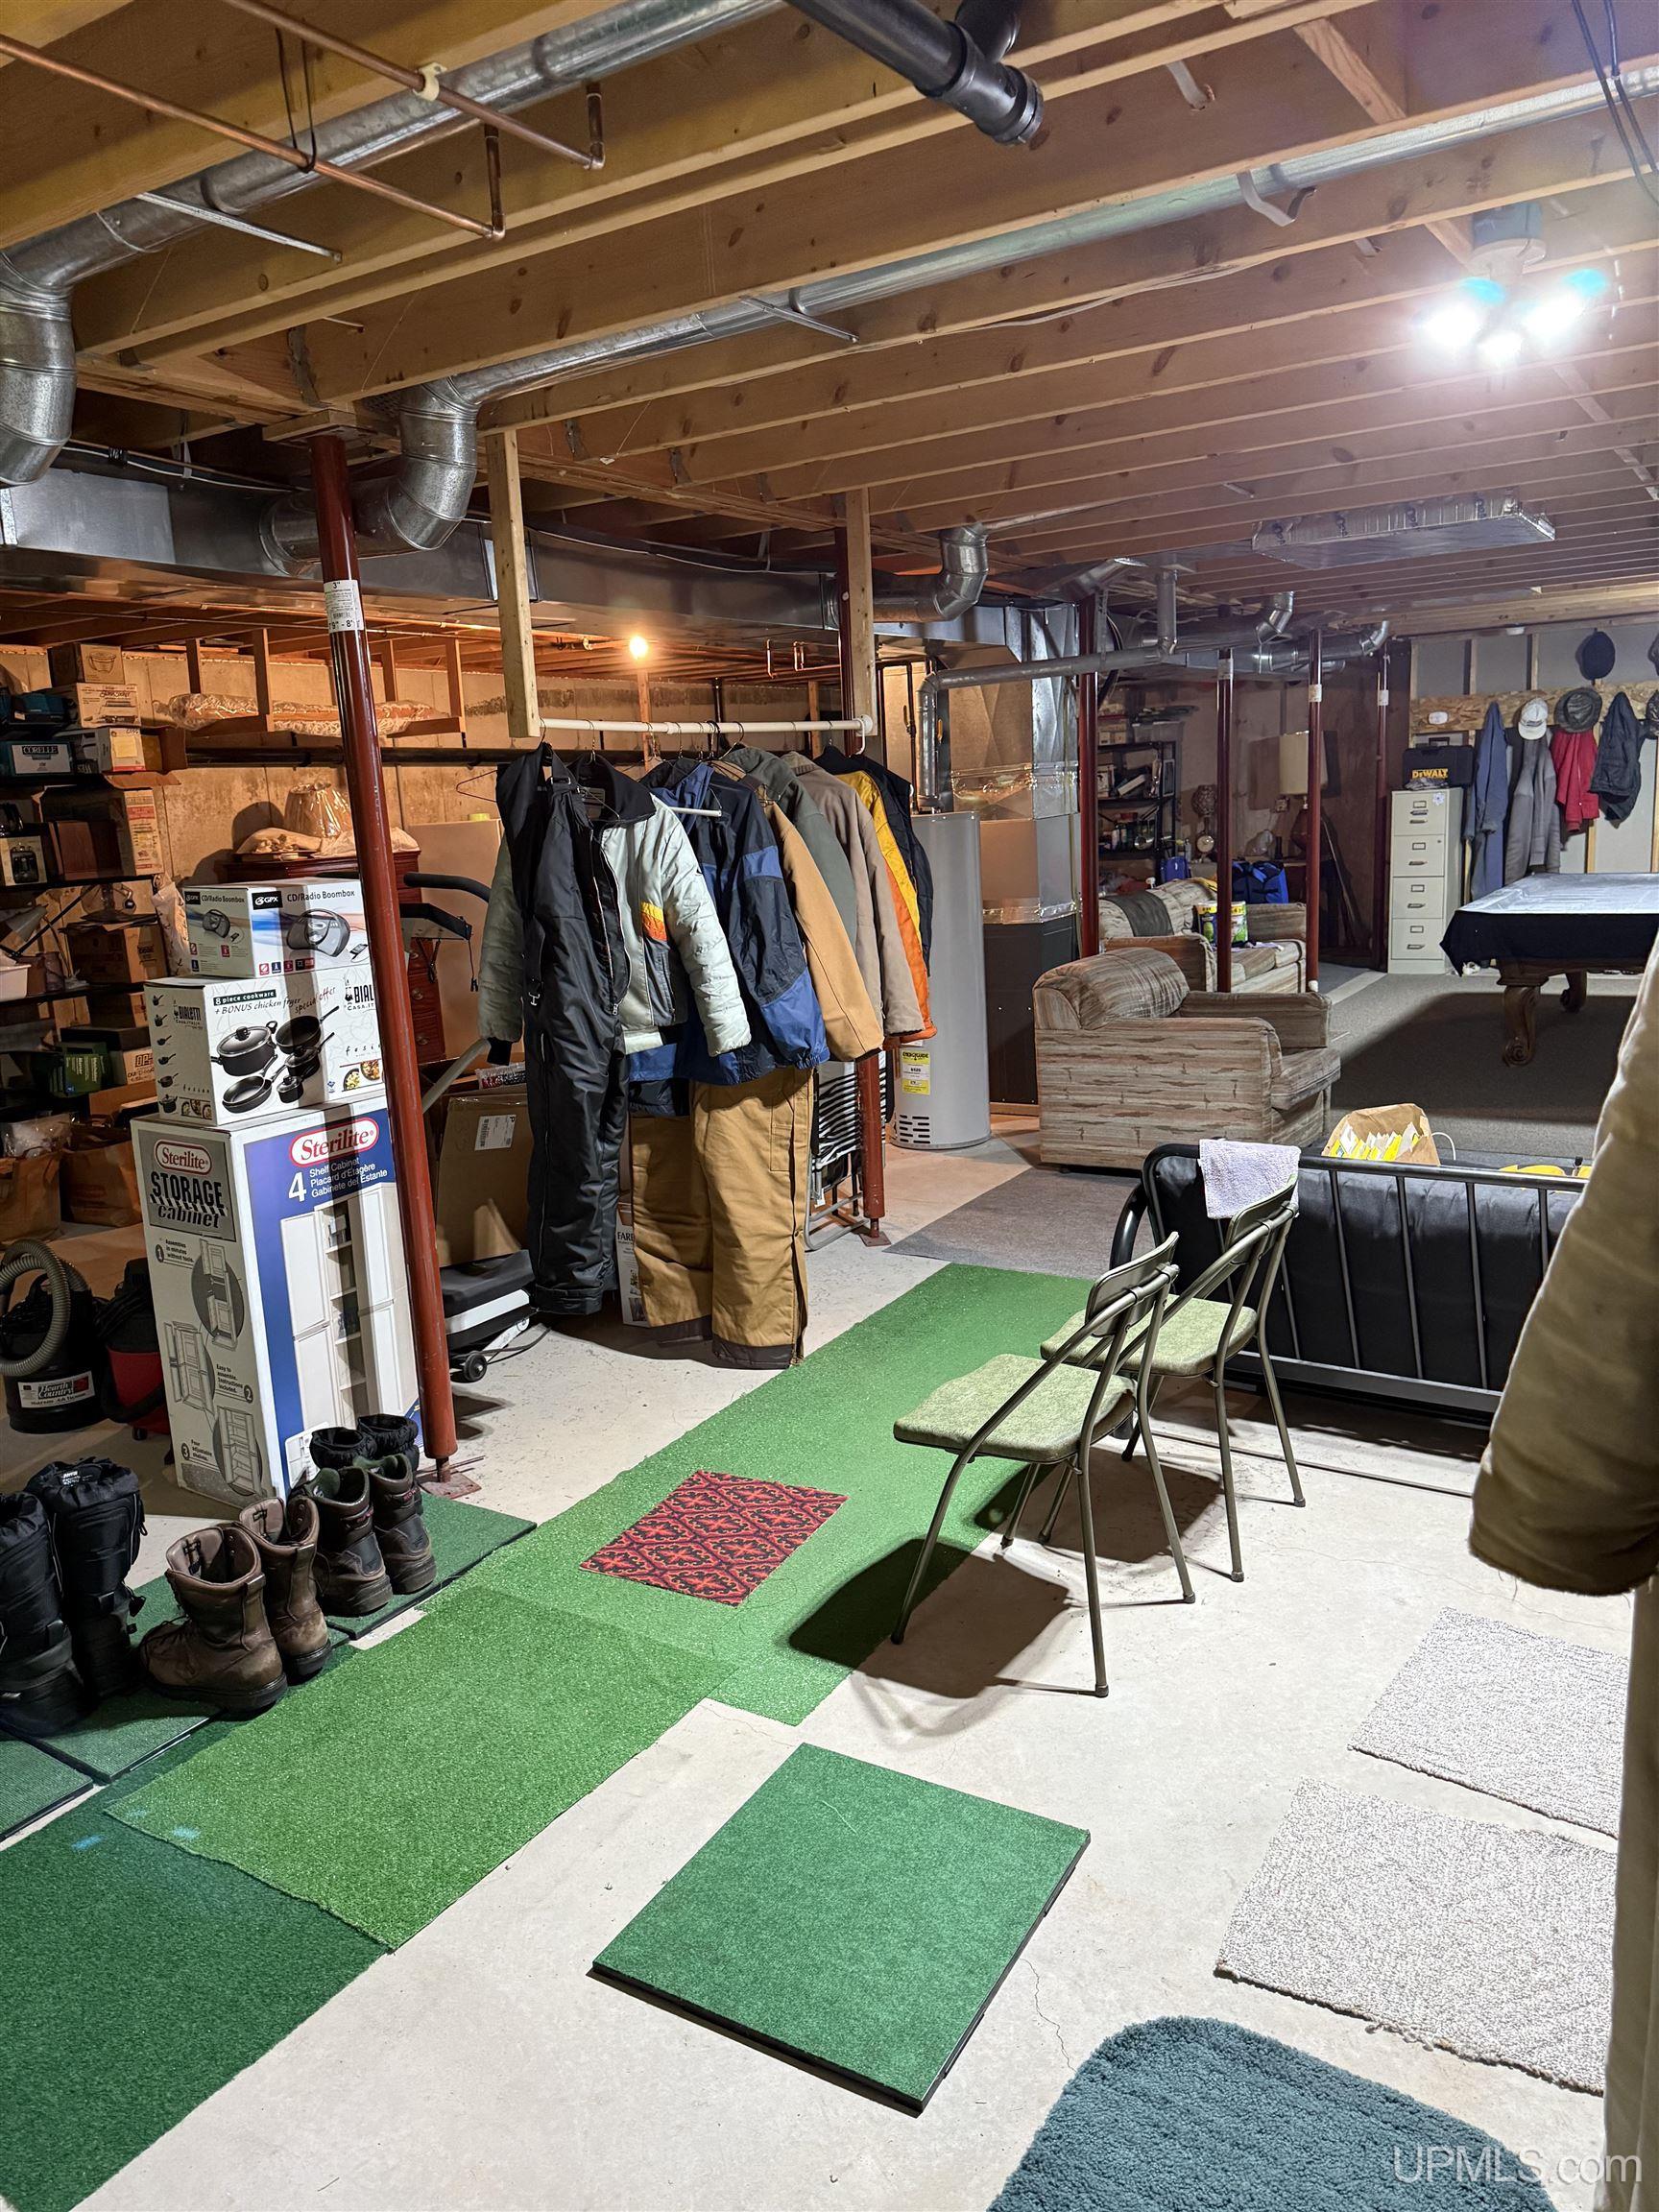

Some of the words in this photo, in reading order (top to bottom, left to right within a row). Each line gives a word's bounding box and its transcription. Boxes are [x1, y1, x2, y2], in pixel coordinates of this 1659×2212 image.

[22, 745, 59, 755] CORELLE
[201, 894, 222, 902] CD/Radio
[222, 895, 245, 903] Boombox
[287, 891, 322, 902] CD/Radio
[322, 889, 355, 900] Boombox
[215, 998, 222, 1006] 8
[222, 995, 242, 1003] piece
[243, 990, 275, 1000] cookware
[353, 984, 374, 1004] BIAL
[221, 1001, 252, 1015] BONUS
[253, 999, 281, 1010] chicken
[282, 997, 301, 1009] fryer
[295, 996, 318, 1014] special
[301, 1128, 370, 1161] Sterilite
[162, 1147, 206, 1169] Sterilite
[309, 1164, 328, 1178] Shelf
[331, 1157, 360, 1171] Cabinet
[151, 1170, 225, 1209] STORAGE
[289, 1171, 307, 1202] 4
[310, 1172, 340, 1188] Placard
[311, 1182, 346, 1198] Gabinete
[360, 1169, 388, 1184] Estante
[157, 1205, 221, 1228] cabinet
